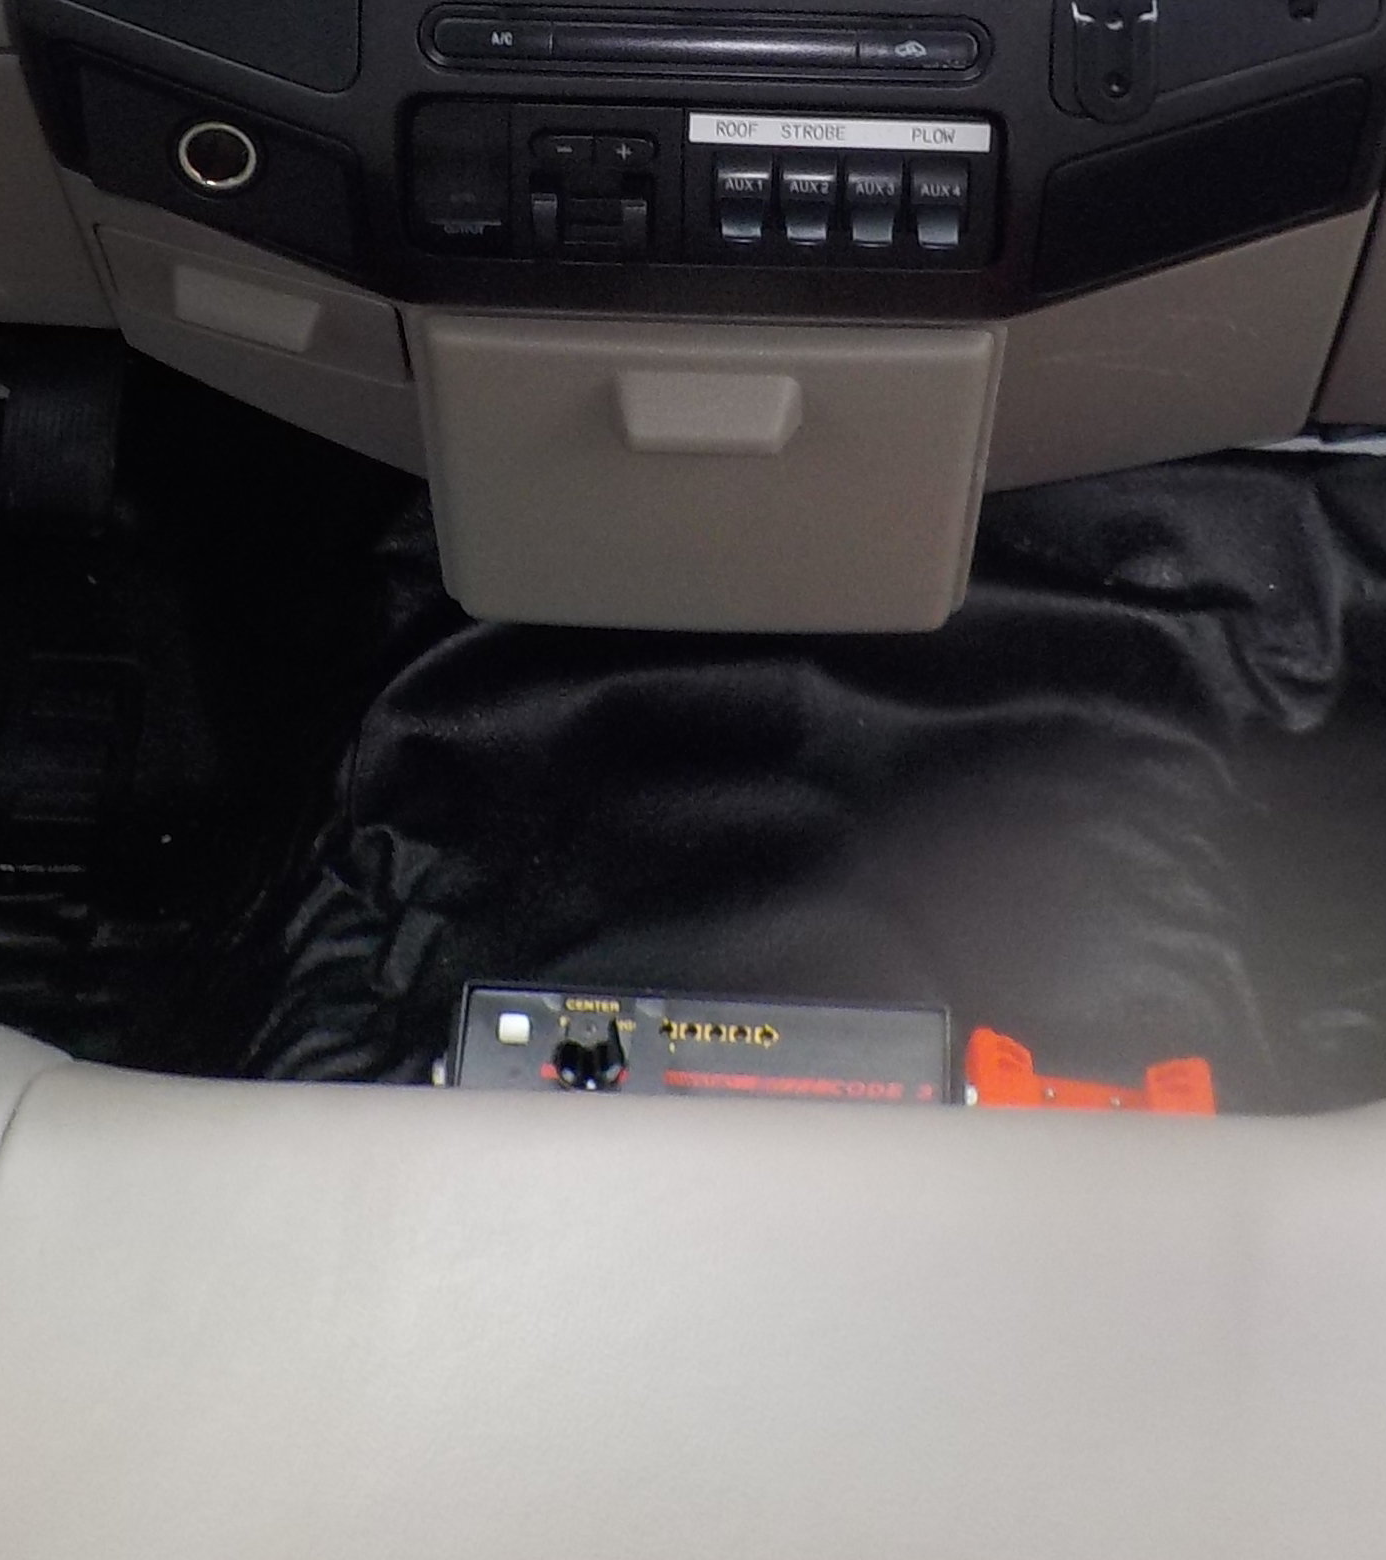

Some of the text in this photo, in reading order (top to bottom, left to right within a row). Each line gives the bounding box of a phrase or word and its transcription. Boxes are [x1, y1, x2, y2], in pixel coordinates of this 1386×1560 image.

[491, 31, 513, 47] A/C
[715, 119, 956, 145] ROOF STROBE PLOW
[724, 178, 753, 192] AUX
[789, 180, 819, 194] AUX
[855, 182, 885, 196] AUX
[920, 184, 951, 197] AUX
[565, 998, 620, 1014] CENTER
